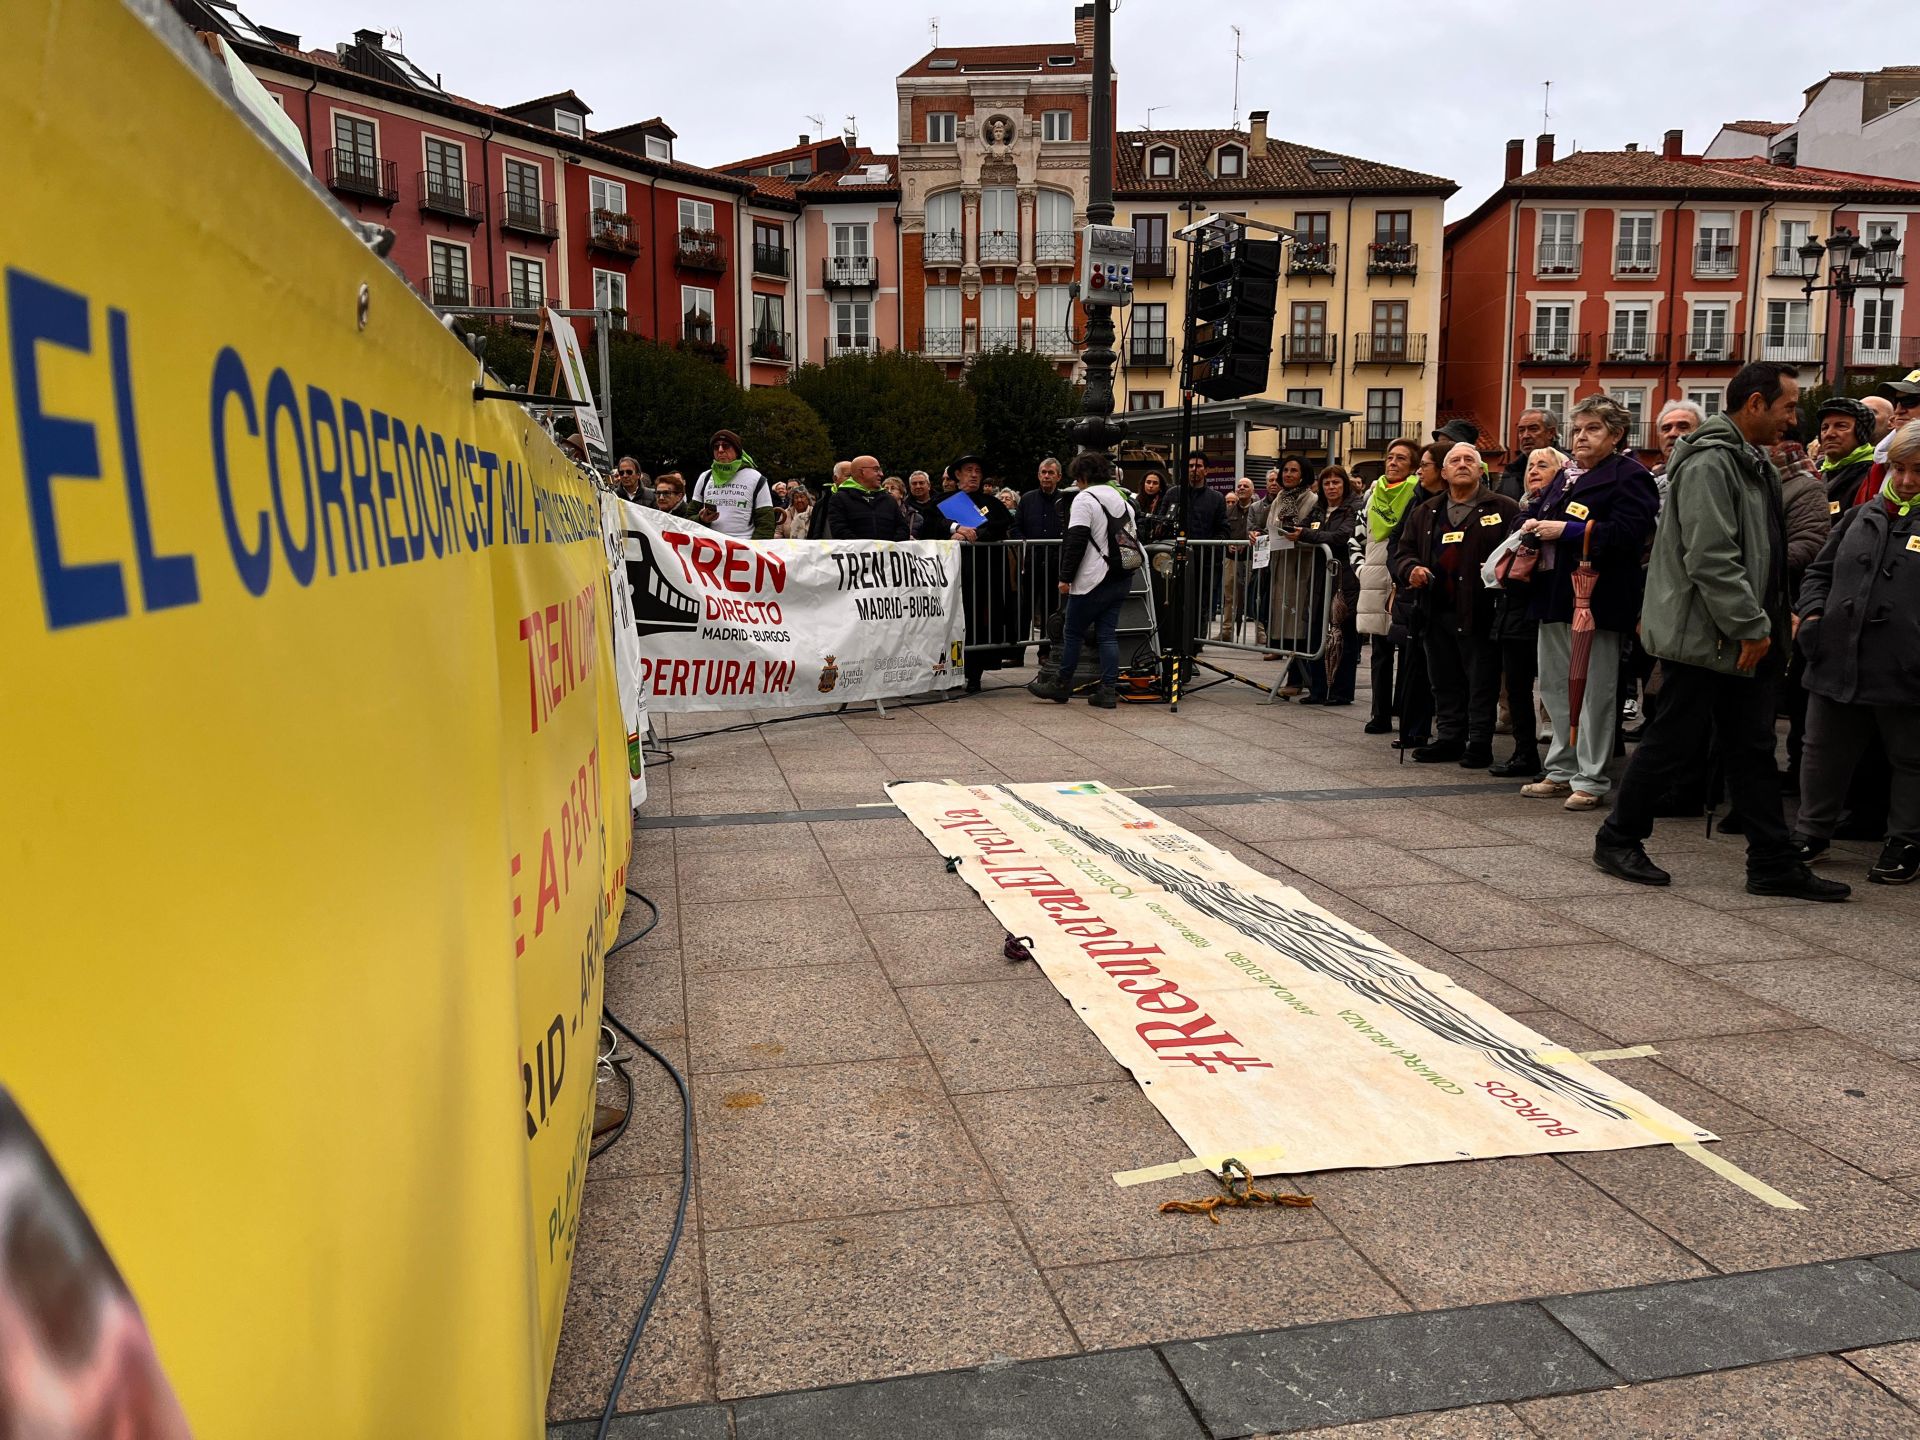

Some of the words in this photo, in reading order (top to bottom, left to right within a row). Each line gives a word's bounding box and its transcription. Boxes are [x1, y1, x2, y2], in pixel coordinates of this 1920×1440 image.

[5, 266, 202, 633] EL
[210, 345, 460, 598] CORREDOR
[662, 530, 786, 593] TREN
[831, 551, 887, 590] TREN
[705, 595, 783, 625] DIRECTO
[519, 599, 575, 735] TREN
[640, 658, 756, 696] PERTURA
[763, 659, 796, 694] YA!
[1224, 951, 1264, 976] DUERO
[1252, 974, 1277, 985] DE
[1337, 1009, 1401, 1049] ARLANZA
[1391, 1049, 1465, 1096] COMARCA
[1474, 1079, 1579, 1138] BURGOS
